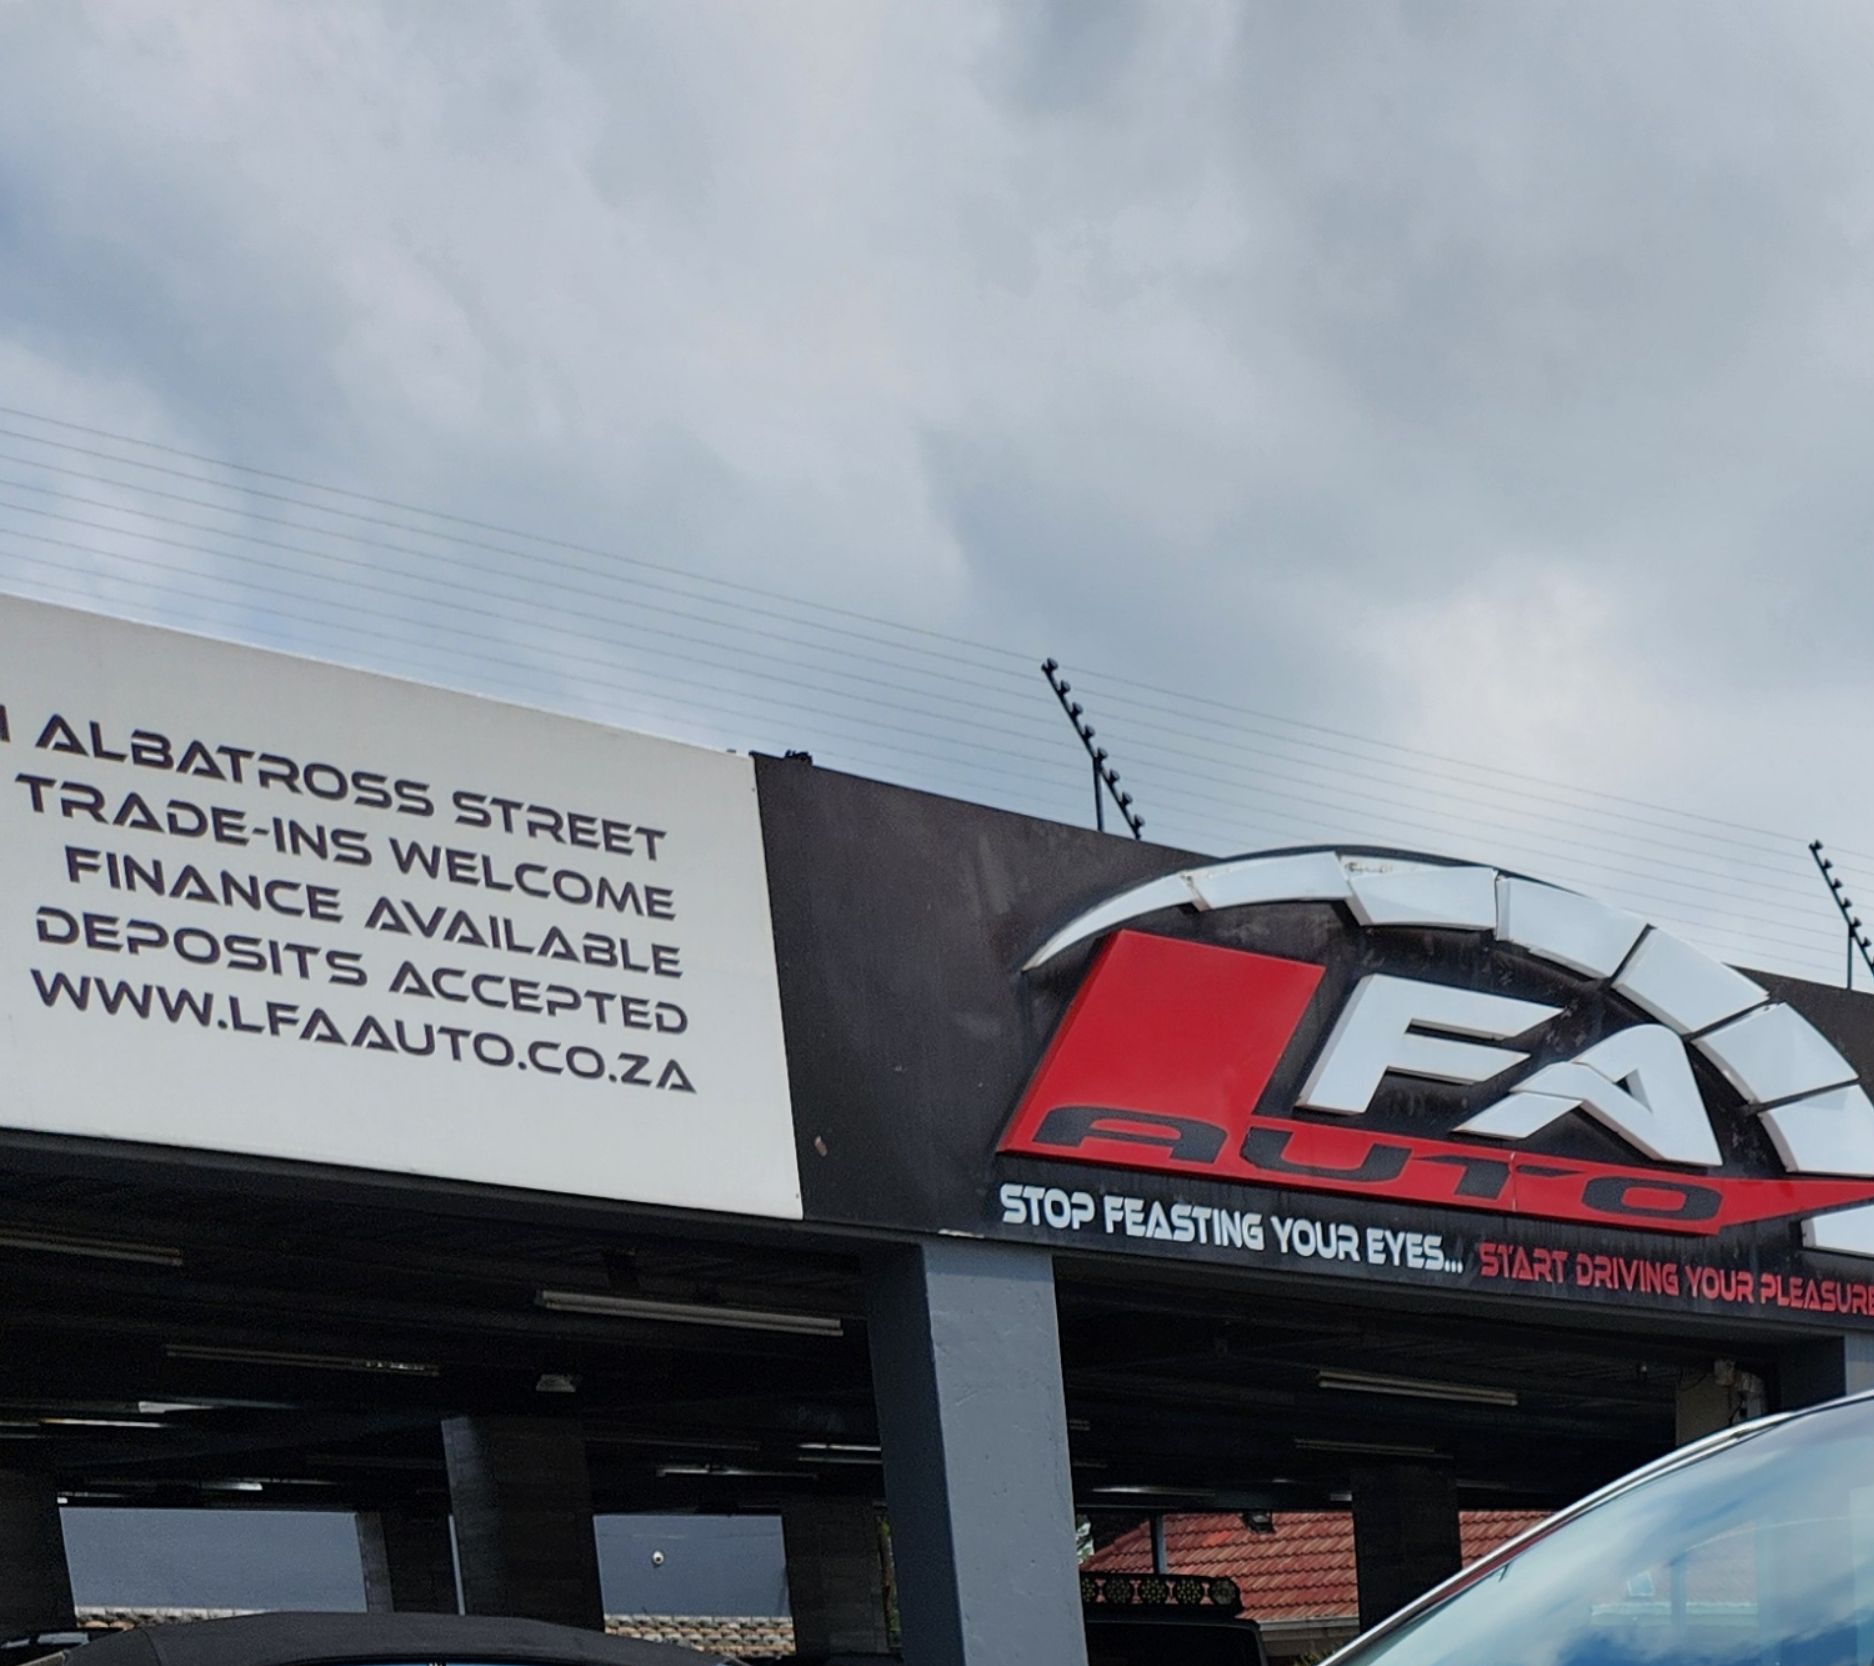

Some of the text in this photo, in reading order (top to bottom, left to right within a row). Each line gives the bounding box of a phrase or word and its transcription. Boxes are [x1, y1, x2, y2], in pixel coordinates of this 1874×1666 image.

[14, 772, 676, 921] TRADE-INS WELCOME
[34, 713, 435, 817] ALBATROSS
[453, 790, 667, 861] STREET
[36, 906, 688, 1034] DEPOSITS ACCEPTED
[64, 845, 683, 979] FINANCE AVAILABLE
[30, 968, 695, 1093] WWW.LFAAUTO.CO.ZA
[1000, 928, 1722, 1170] LFA
[1034, 1106, 1723, 1220] AUTO
[1000, 1182, 1096, 1231] STOP
[1103, 1194, 1265, 1251] FEASTING
[1270, 1214, 1361, 1262] YOUR
[1366, 1227, 1465, 1275] EYES...
[1478, 1241, 1568, 1284] START
[1575, 1252, 1679, 1297] DRIVING
[1684, 1265, 1754, 1304] YOUR
